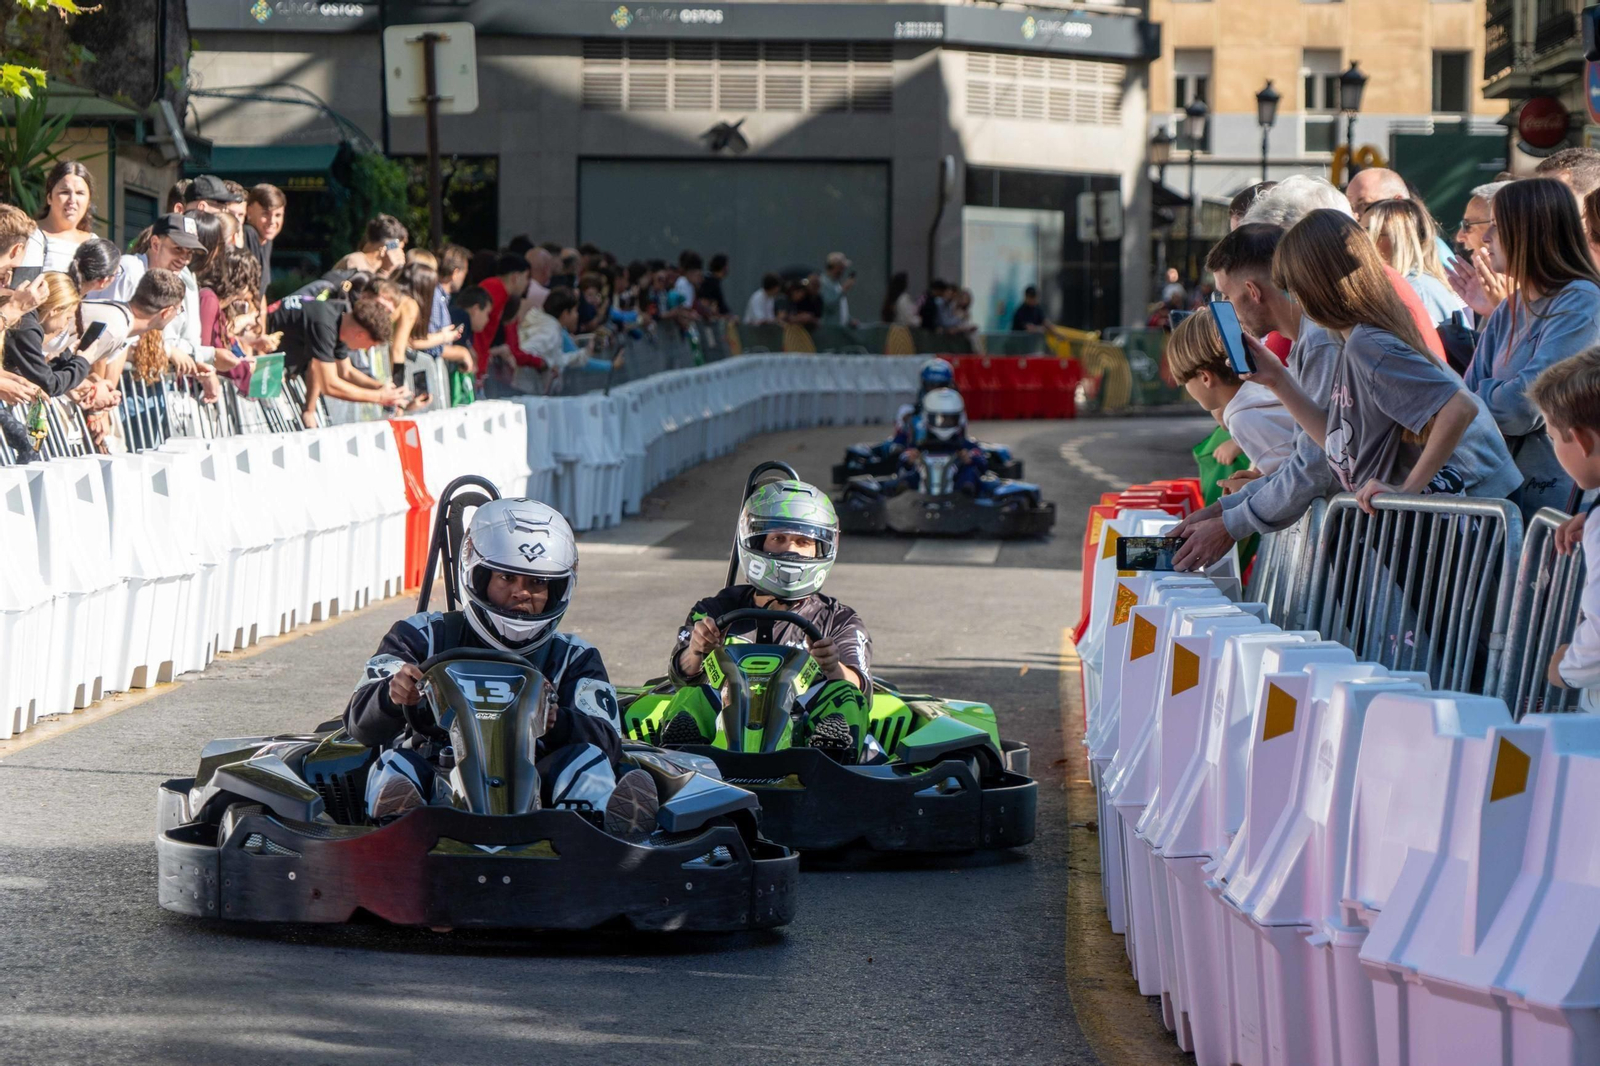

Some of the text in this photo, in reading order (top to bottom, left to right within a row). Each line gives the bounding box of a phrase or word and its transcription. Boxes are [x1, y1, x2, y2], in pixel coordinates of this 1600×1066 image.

[1524, 477, 1558, 494] Angel
[748, 560, 766, 580] 9
[738, 655, 780, 674] 9
[457, 678, 515, 704] 13
